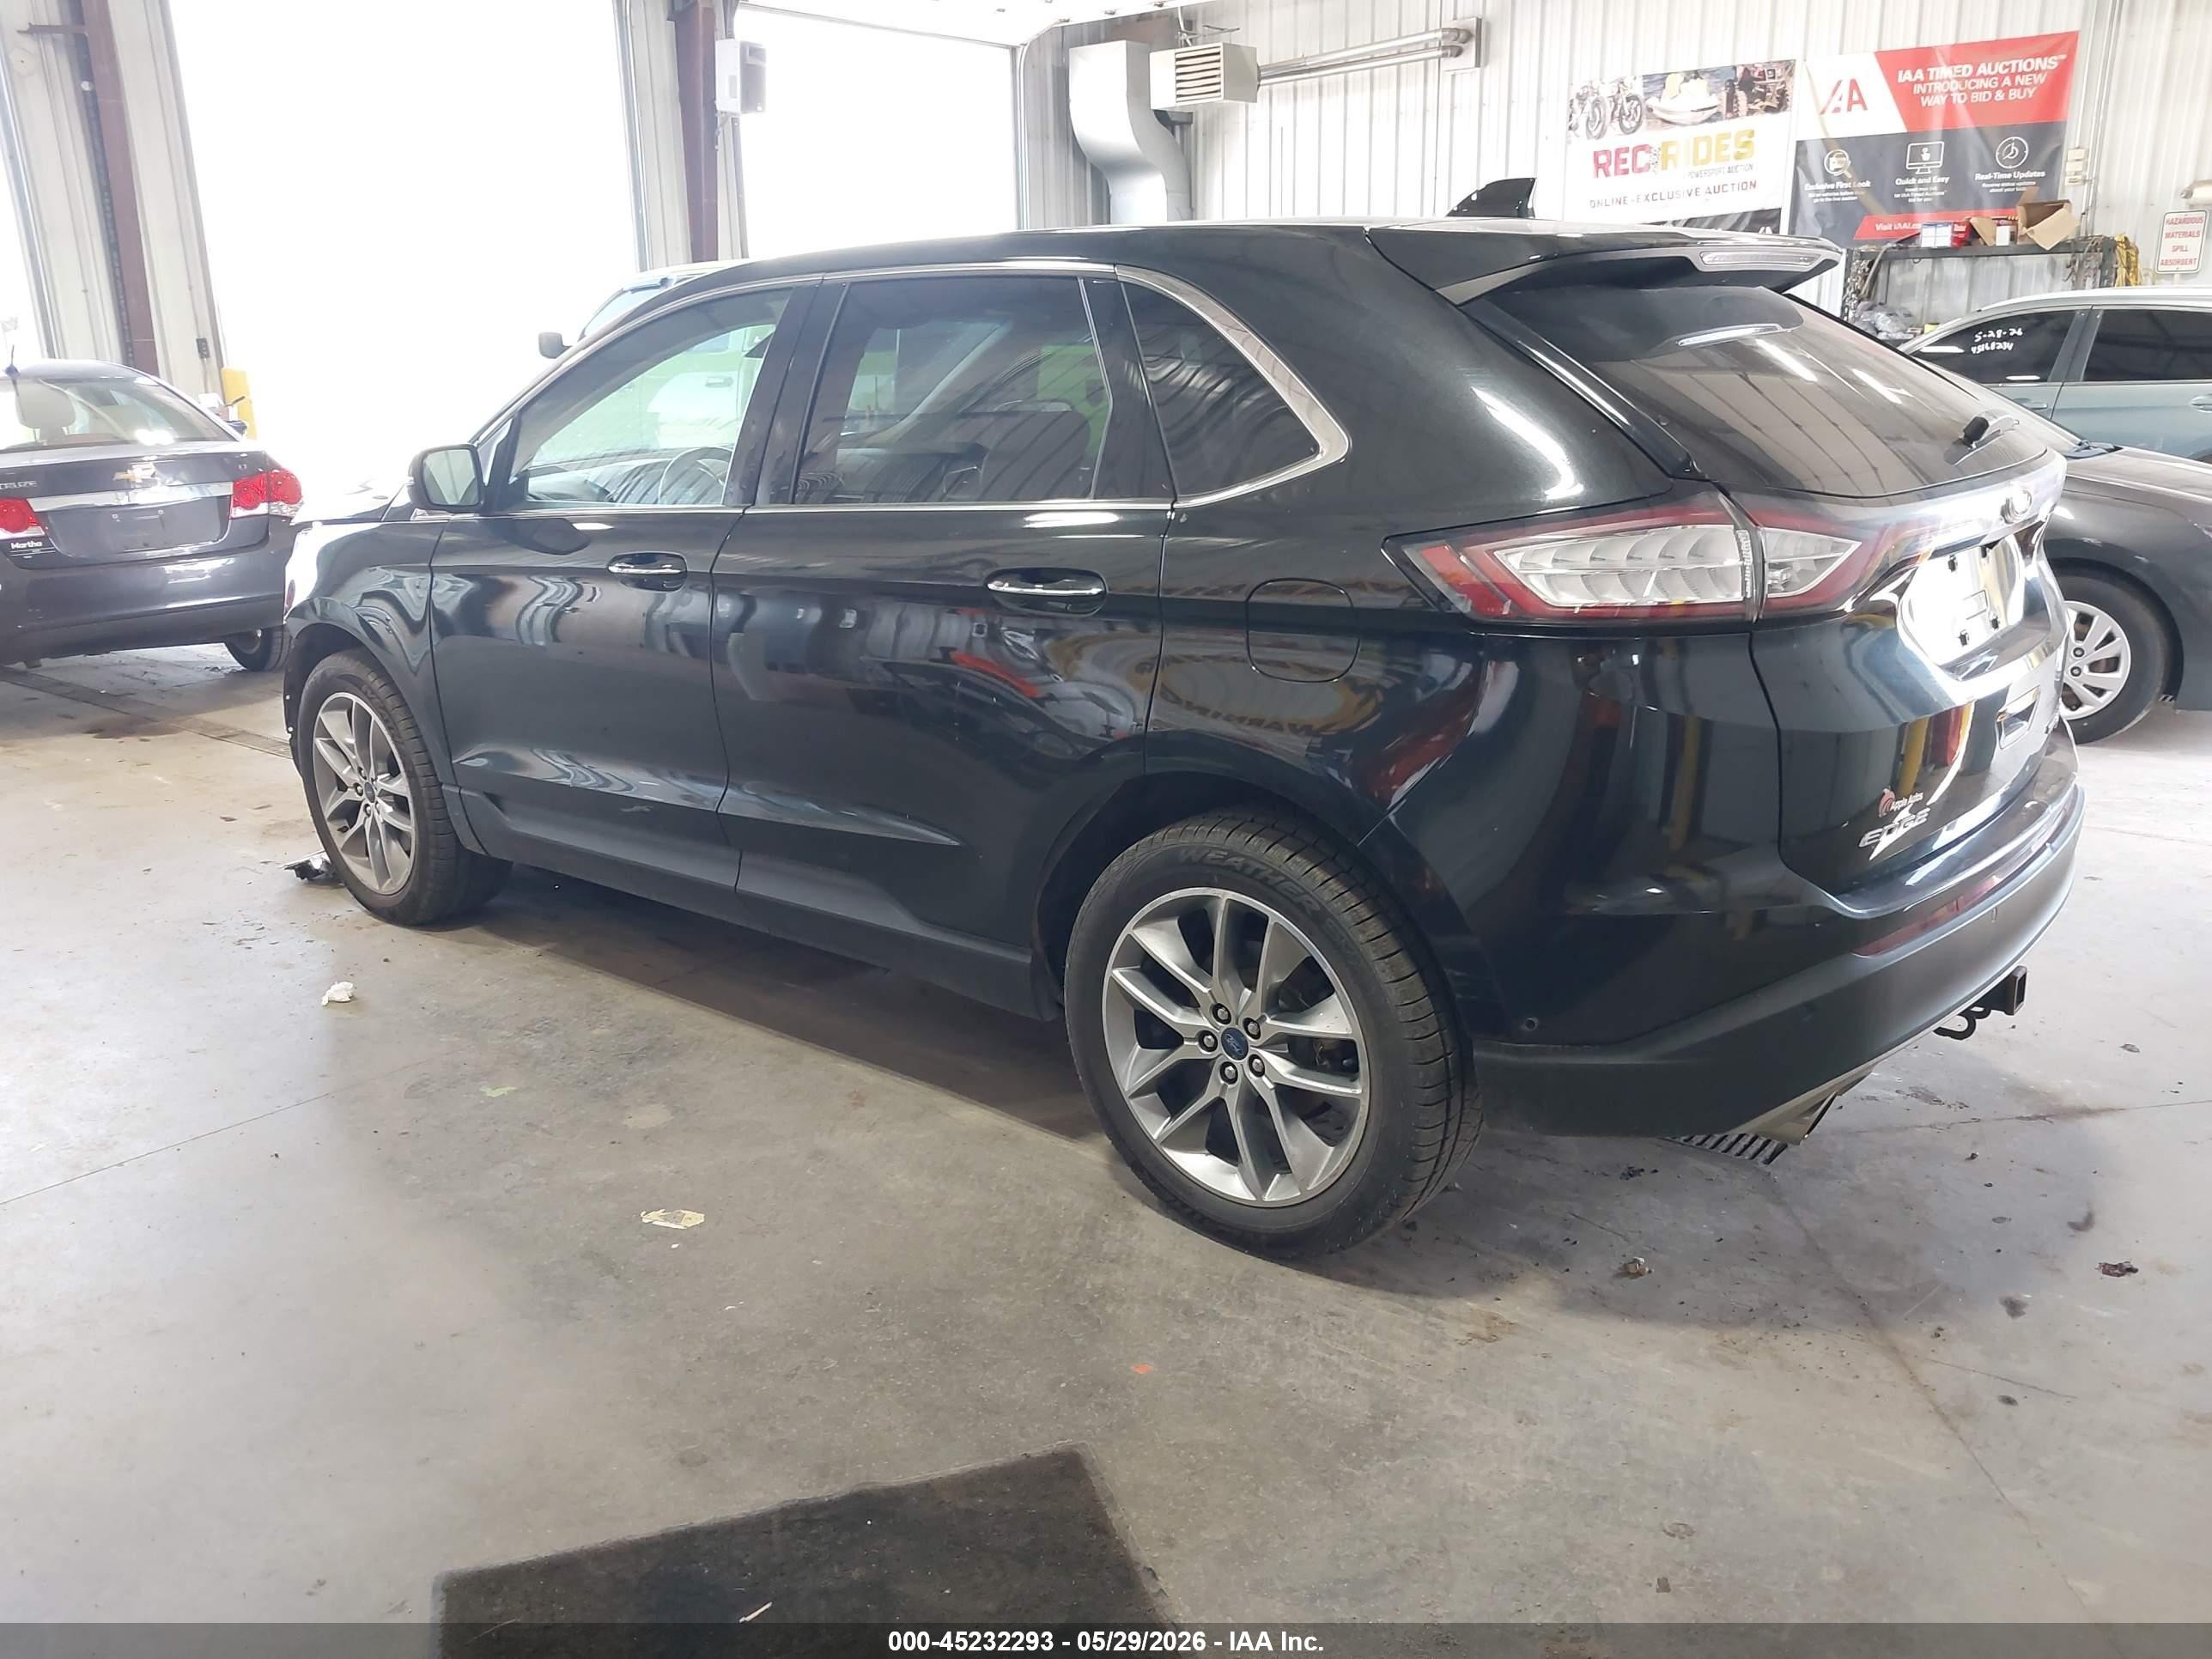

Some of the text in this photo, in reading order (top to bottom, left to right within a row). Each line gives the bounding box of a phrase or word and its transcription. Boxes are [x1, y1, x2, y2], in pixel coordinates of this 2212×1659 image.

[1898, 69, 1923, 83] IAA
[1928, 64, 1972, 81] TIMED
[1913, 72, 2048, 95] INTRODUCING A NEW
[1920, 86, 2038, 107] WAY TO BID & BUY
[1593, 143, 1652, 179] REC
[1895, 177, 1917, 185] Quick
[1933, 175, 1951, 185] Easy
[1975, 170, 2045, 180] Real-Time Updates
[1705, 179, 1758, 196] AUCTION
[1804, 179, 1872, 191] Exclusive First Look
[1875, 222, 1893, 231] Visit
[2166, 216, 2203, 226] HAZARDOUS
[2165, 230, 2201, 239] MATERIALS
[2160, 258, 2197, 266] ABSORBENT
[1974, 327, 2023, 343] 5-28-26
[1858, 807, 1931, 848] EDGE
[1179, 848, 1322, 915] WEATHER
